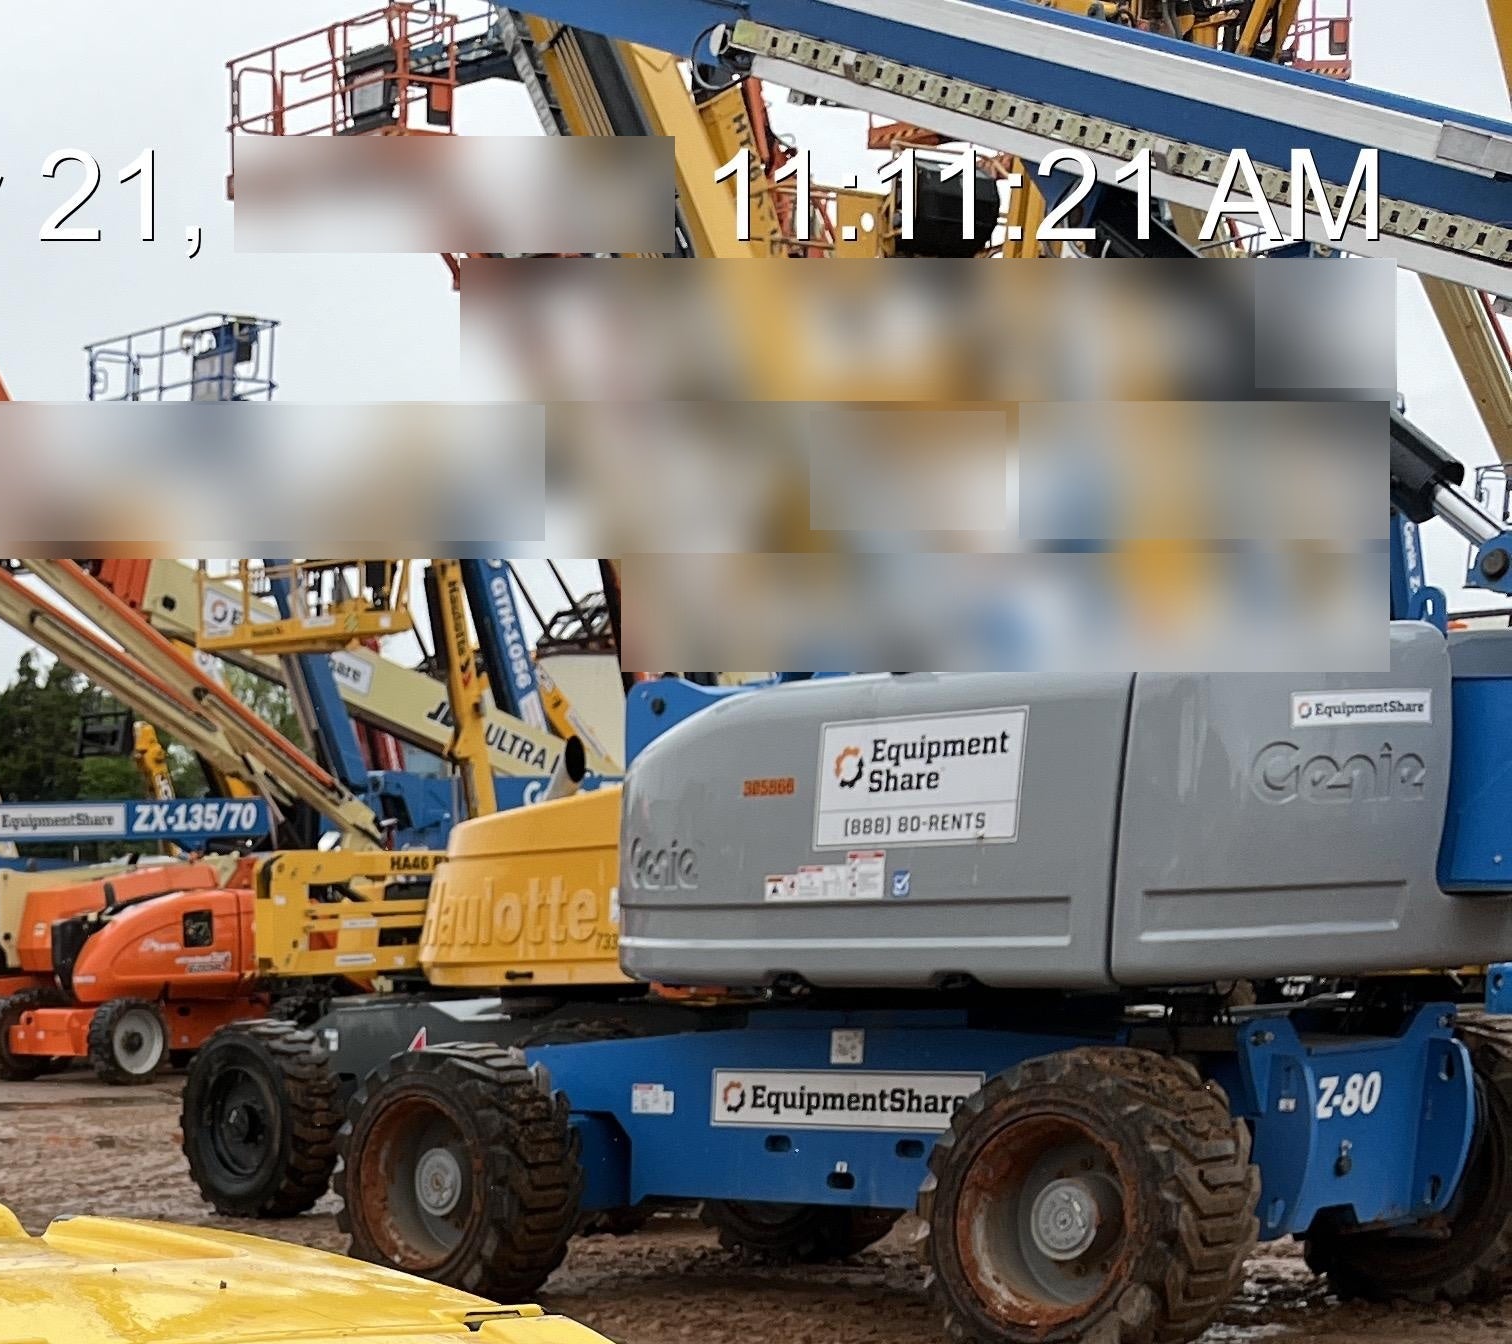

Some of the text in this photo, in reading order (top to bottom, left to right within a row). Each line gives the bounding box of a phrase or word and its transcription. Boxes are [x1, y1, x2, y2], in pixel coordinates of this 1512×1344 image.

[489, 576, 533, 691] GTH-1056
[1315, 700, 1425, 718] EquipmentShare
[485, 723, 548, 770] ULTRA
[872, 730, 1010, 767] Equipment
[868, 769, 941, 794] Share
[1252, 741, 1426, 805] Genie
[1, 802, 258, 833] EquipmentShare ZX-135/70
[844, 812, 986, 837] (888) 80-RENTS
[390, 855, 429, 872] HA46
[419, 876, 600, 948] Haulotte
[1316, 1071, 1382, 1120] Z-80
